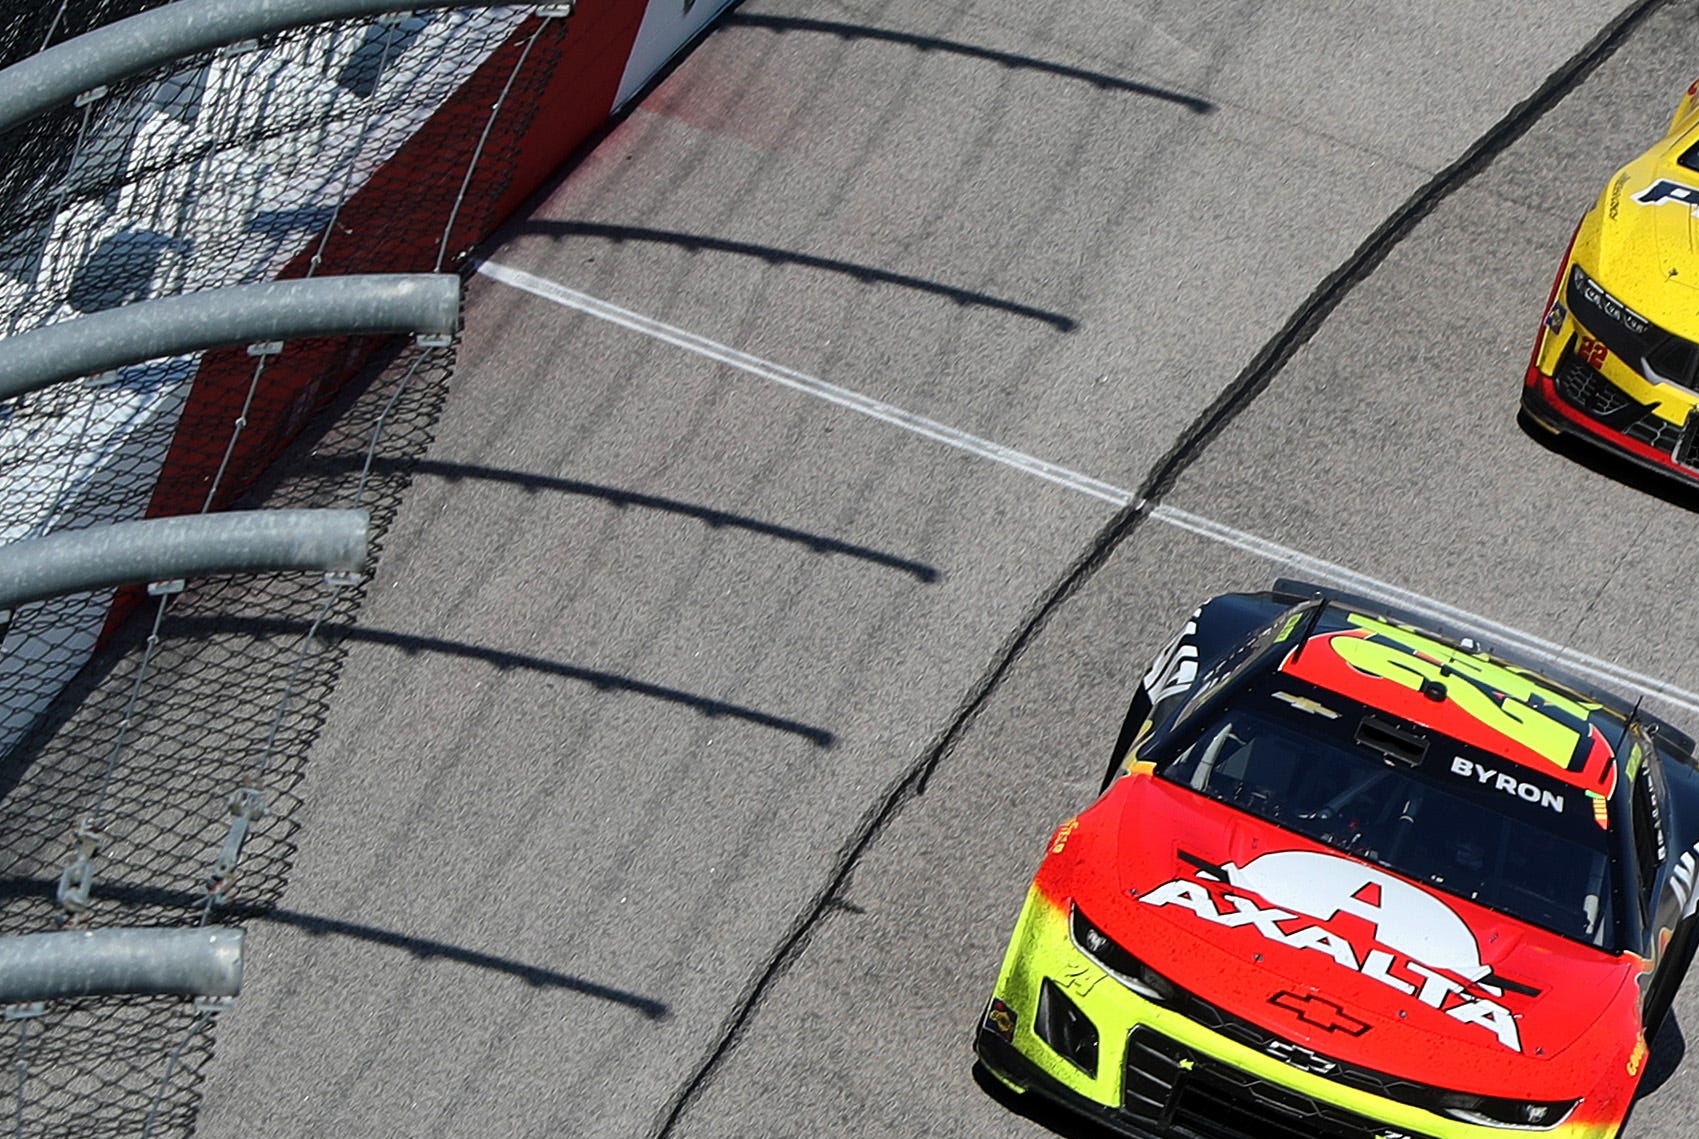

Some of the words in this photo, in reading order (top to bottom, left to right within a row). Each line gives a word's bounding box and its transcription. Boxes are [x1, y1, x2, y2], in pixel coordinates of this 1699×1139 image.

[1578, 336, 1609, 370] 22
[1450, 756, 1564, 813] BYRON
[1139, 878, 1523, 1053] AXALTA
